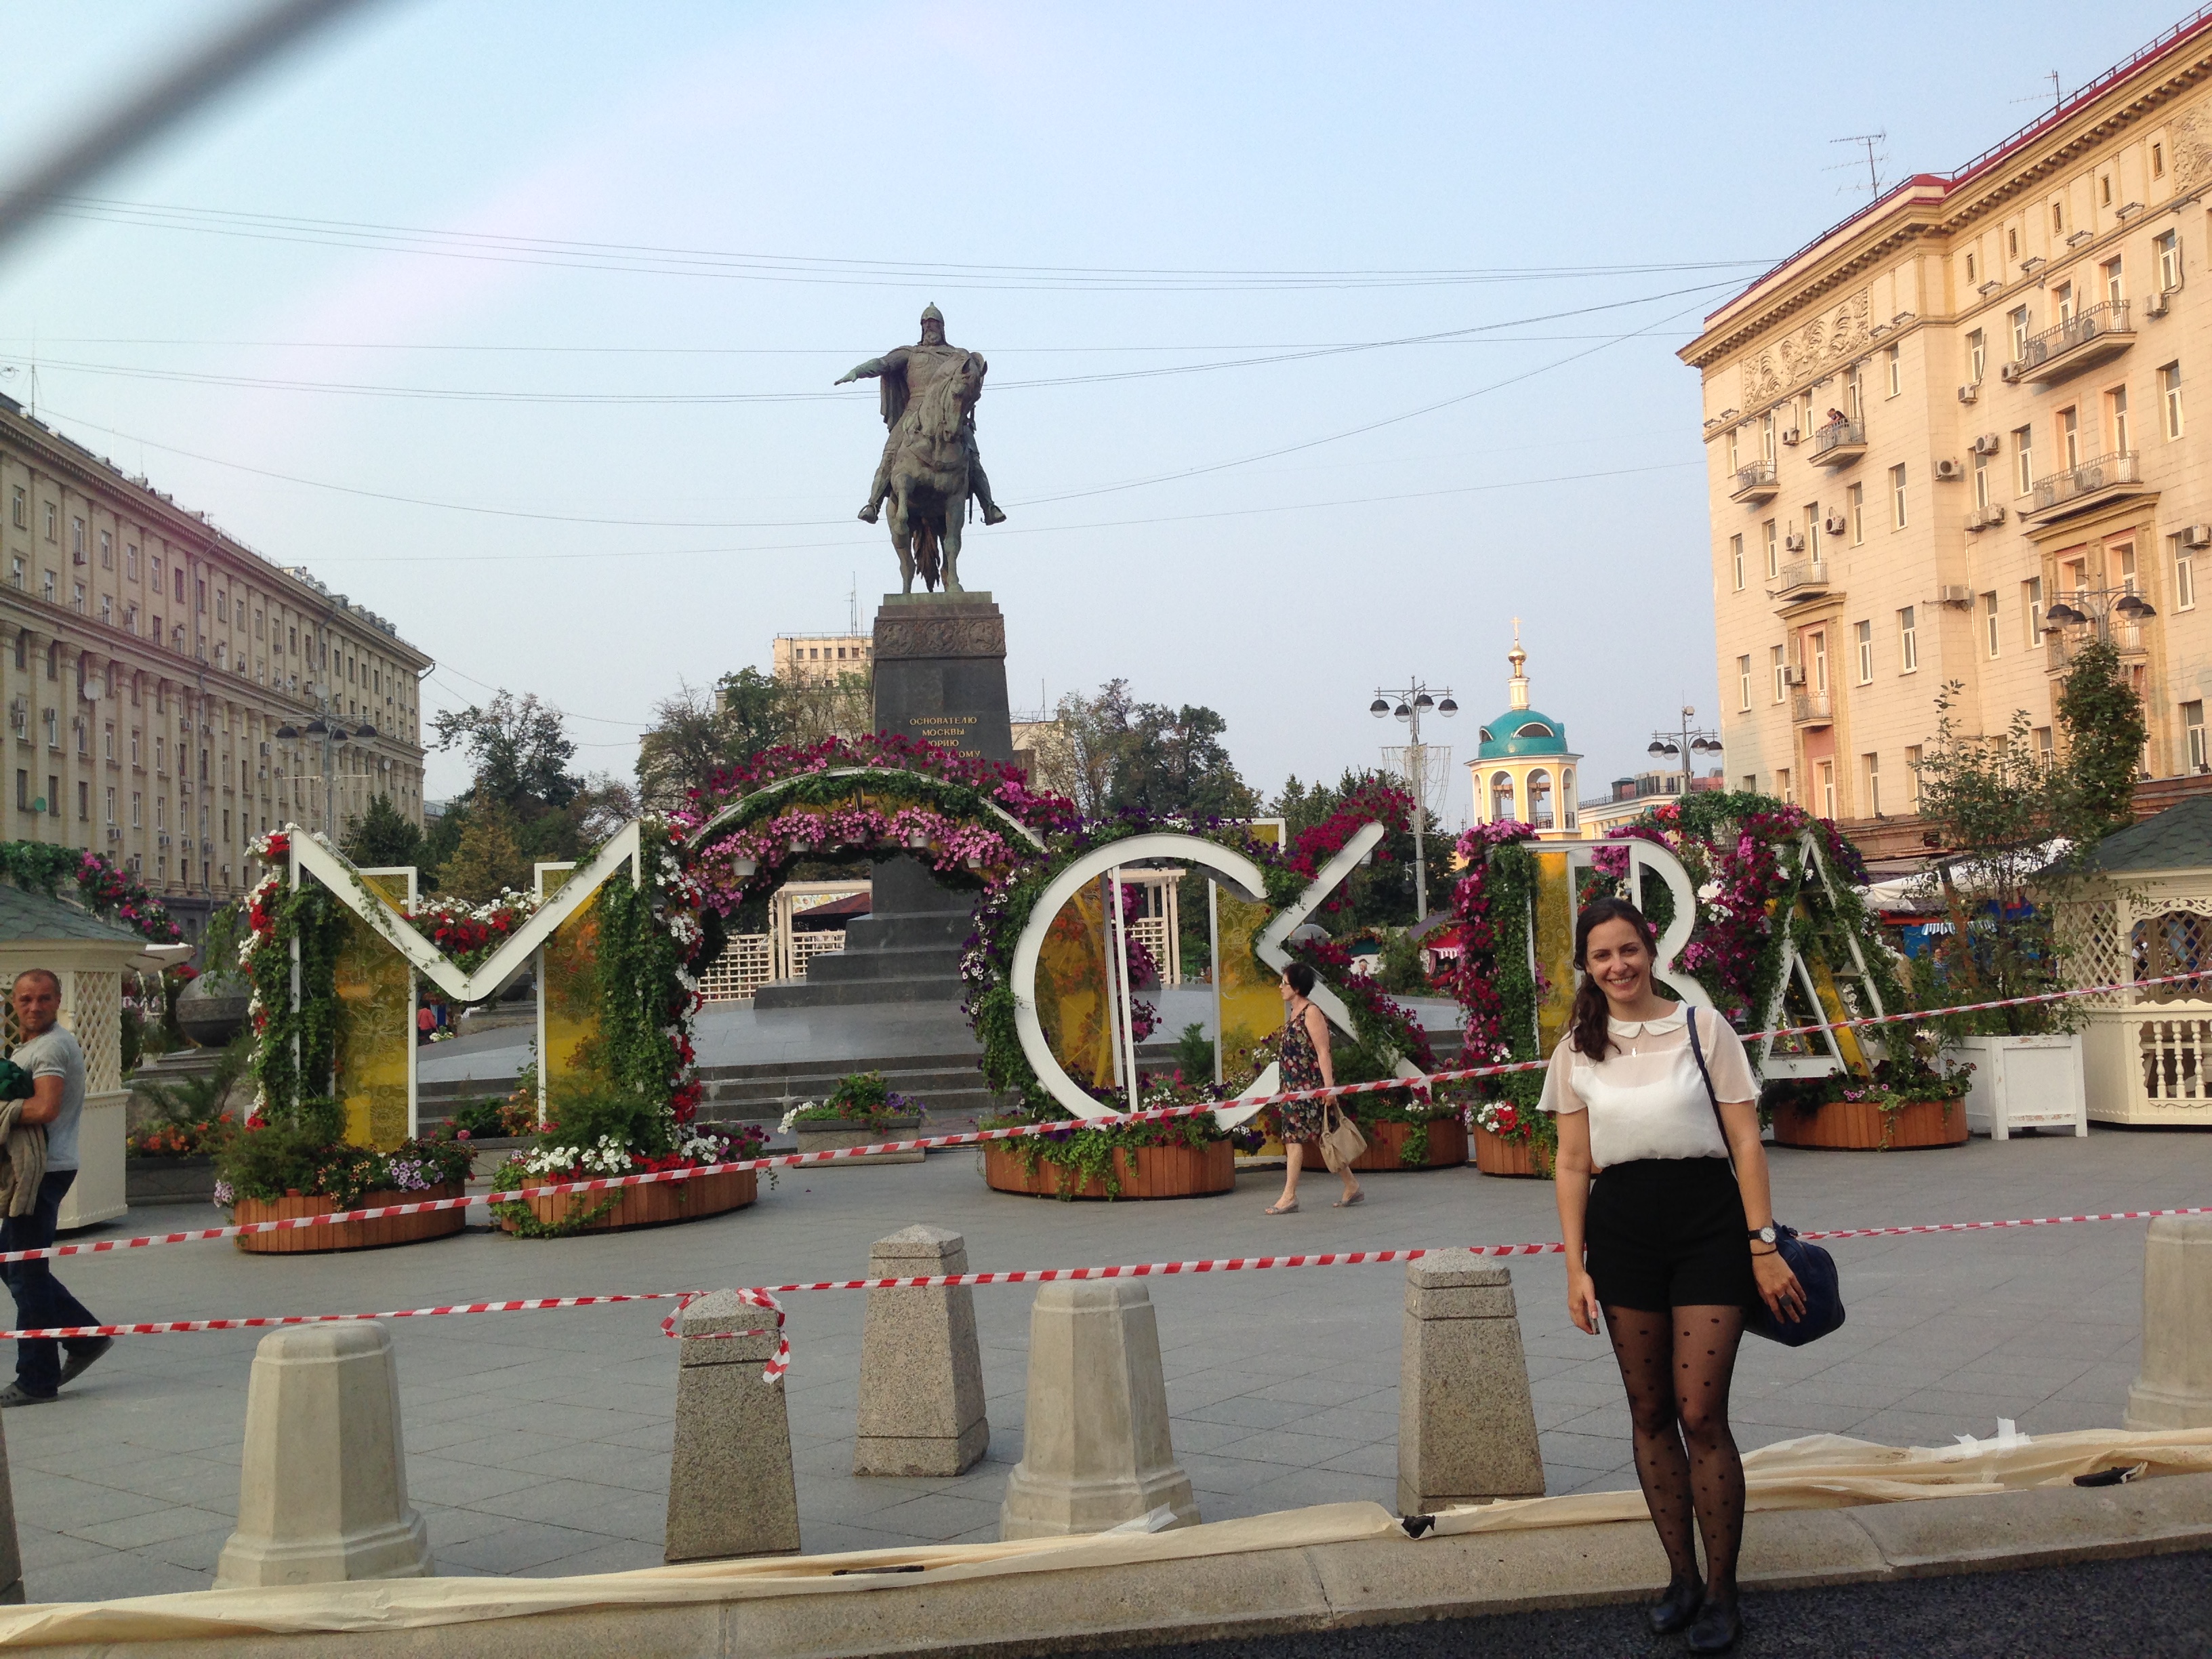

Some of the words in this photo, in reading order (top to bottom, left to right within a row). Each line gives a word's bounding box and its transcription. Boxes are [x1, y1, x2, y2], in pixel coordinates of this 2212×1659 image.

[909, 716, 977, 726] ОСНОВАТЕЛЮ
[922, 728, 965, 737] МОСКВЫ
[928, 739, 960, 747] ЮРИЮ
